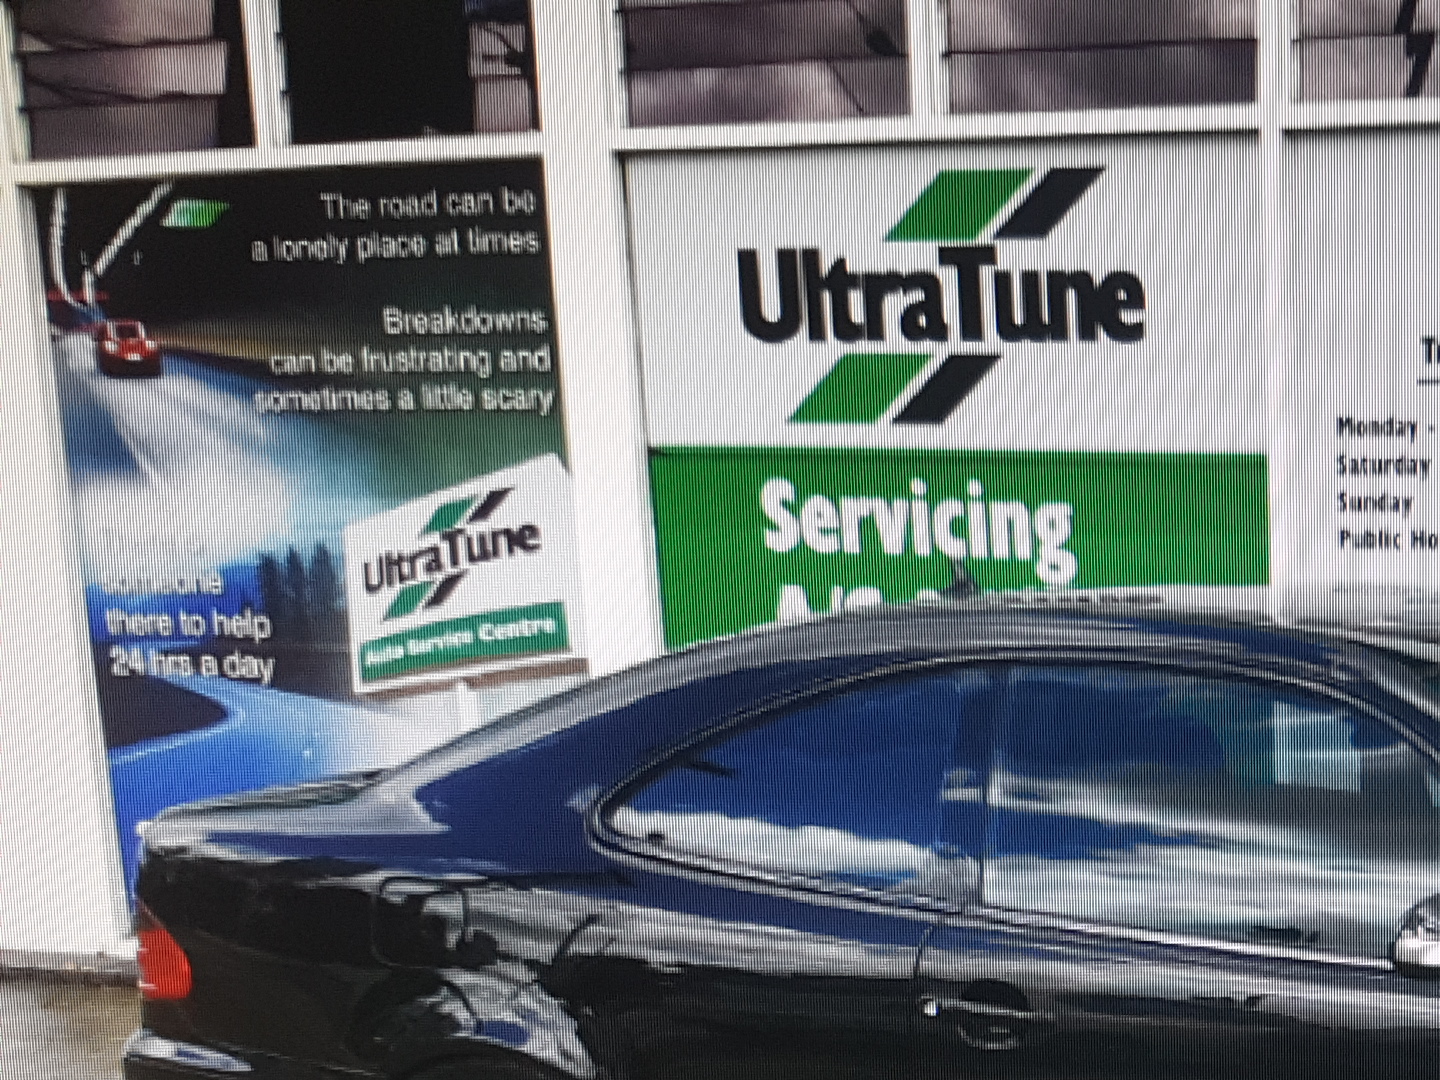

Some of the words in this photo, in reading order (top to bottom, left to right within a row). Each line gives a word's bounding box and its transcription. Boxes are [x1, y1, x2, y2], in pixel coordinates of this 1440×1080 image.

[320, 192, 371, 219] The
[379, 189, 437, 218] road
[445, 192, 494, 216] can
[502, 186, 537, 216] be
[251, 240, 268, 261] a
[273, 233, 348, 264] lonely
[357, 230, 426, 263] place
[435, 228, 459, 257] at
[468, 226, 540, 254] times
[383, 305, 548, 334] Breakdowns
[270, 352, 315, 374] can
[321, 347, 354, 373] be
[361, 345, 491, 378] frustrating
[499, 344, 551, 372] and
[255, 387, 391, 412] sometimes
[398, 390, 414, 410] a
[421, 384, 474, 410] little
[482, 389, 554, 416] scary
[1337, 416, 1417, 442] Monday
[1337, 453, 1431, 480] Saturday
[1338, 492, 1413, 518] Sunday
[761, 476, 1077, 585] Servicing
[1340, 529, 1401, 550] Public
[102, 570, 223, 596] someone
[106, 608, 173, 637] there
[180, 608, 206, 637] to
[212, 607, 273, 644] help
[478, 618, 556, 642] Centre
[110, 645, 145, 676] 24
[149, 649, 195, 677] hrs
[200, 656, 218, 677] a
[223, 650, 276, 685] day
